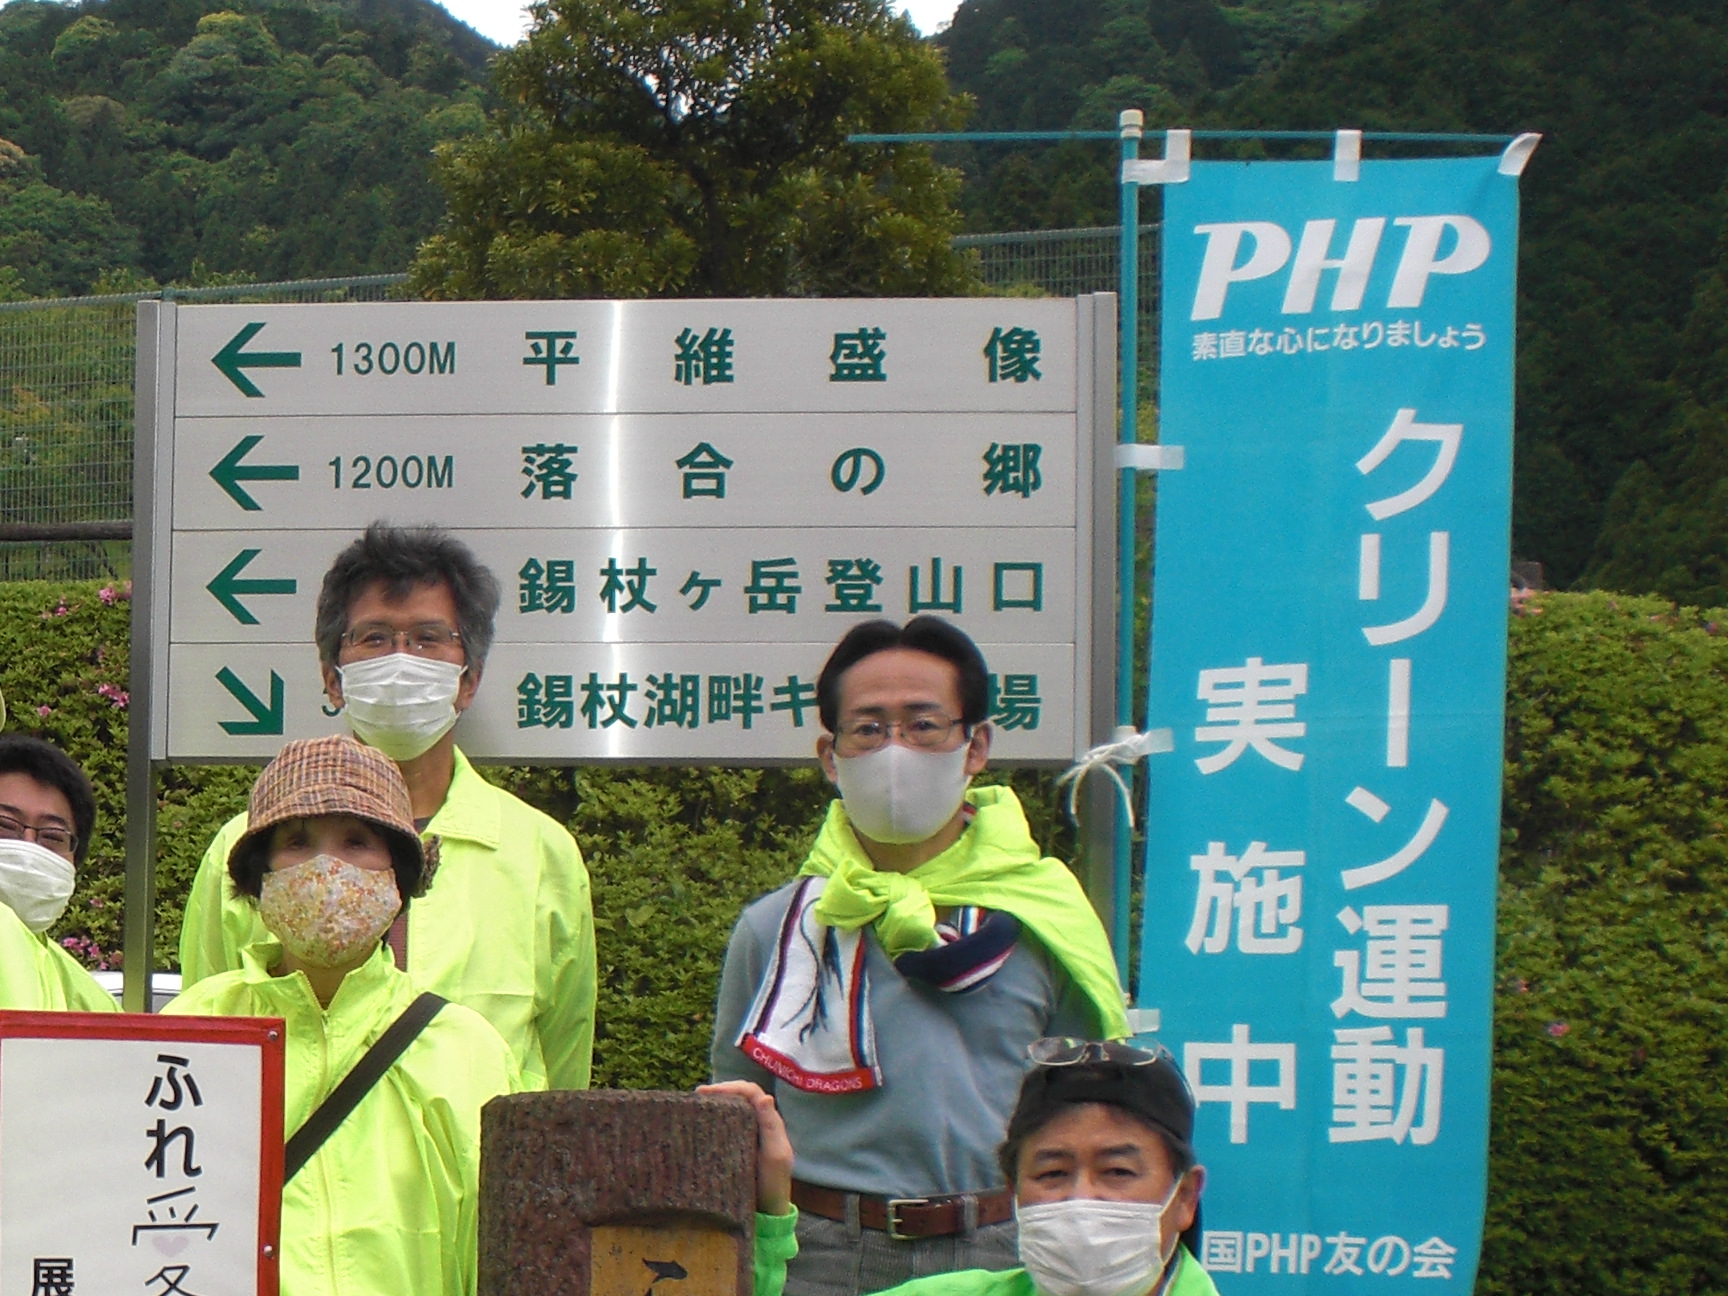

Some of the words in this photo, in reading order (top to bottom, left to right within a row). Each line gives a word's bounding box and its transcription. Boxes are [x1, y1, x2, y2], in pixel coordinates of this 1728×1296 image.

[1190, 214, 1492, 321] PHP
[331, 341, 456, 376] 1300M
[522, 326, 1044, 385] 平維盛像
[1191, 320, 1488, 361] 素直な心になりましょう
[328, 455, 454, 490] 1200M
[521, 443, 1044, 500] 落合の郷
[517, 671, 1044, 731] 錫杖湖畔キ場
[1329, 407, 1465, 1146] クリーン運動
[1183, 656, 1309, 1146] 実施中
[1201, 1230, 1458, 1280] 国PHP友の会
